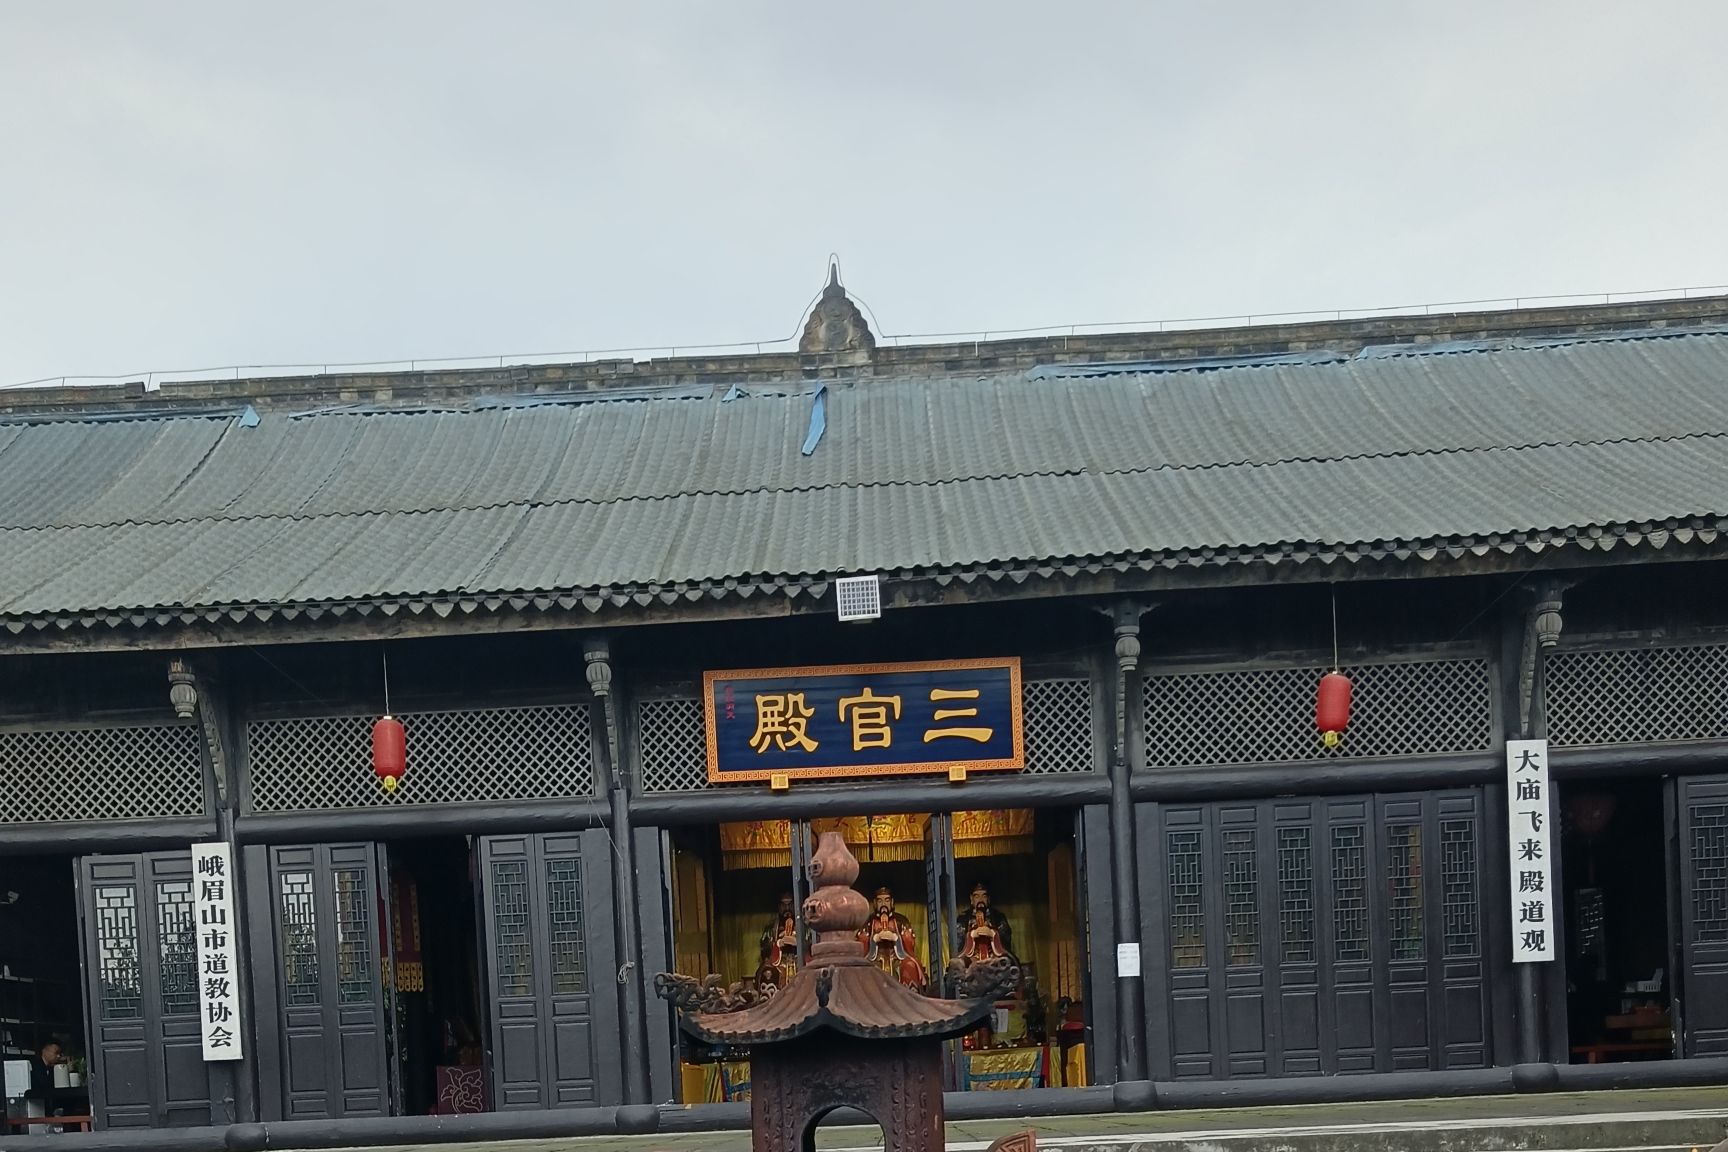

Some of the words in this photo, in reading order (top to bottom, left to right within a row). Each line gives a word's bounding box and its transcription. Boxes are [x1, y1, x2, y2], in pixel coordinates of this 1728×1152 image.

[749, 687, 993, 754] 三官殿
[1514, 749, 1546, 953] 大庙飞来殿道观
[198, 855, 234, 1048] 峨眉山市道教协会
